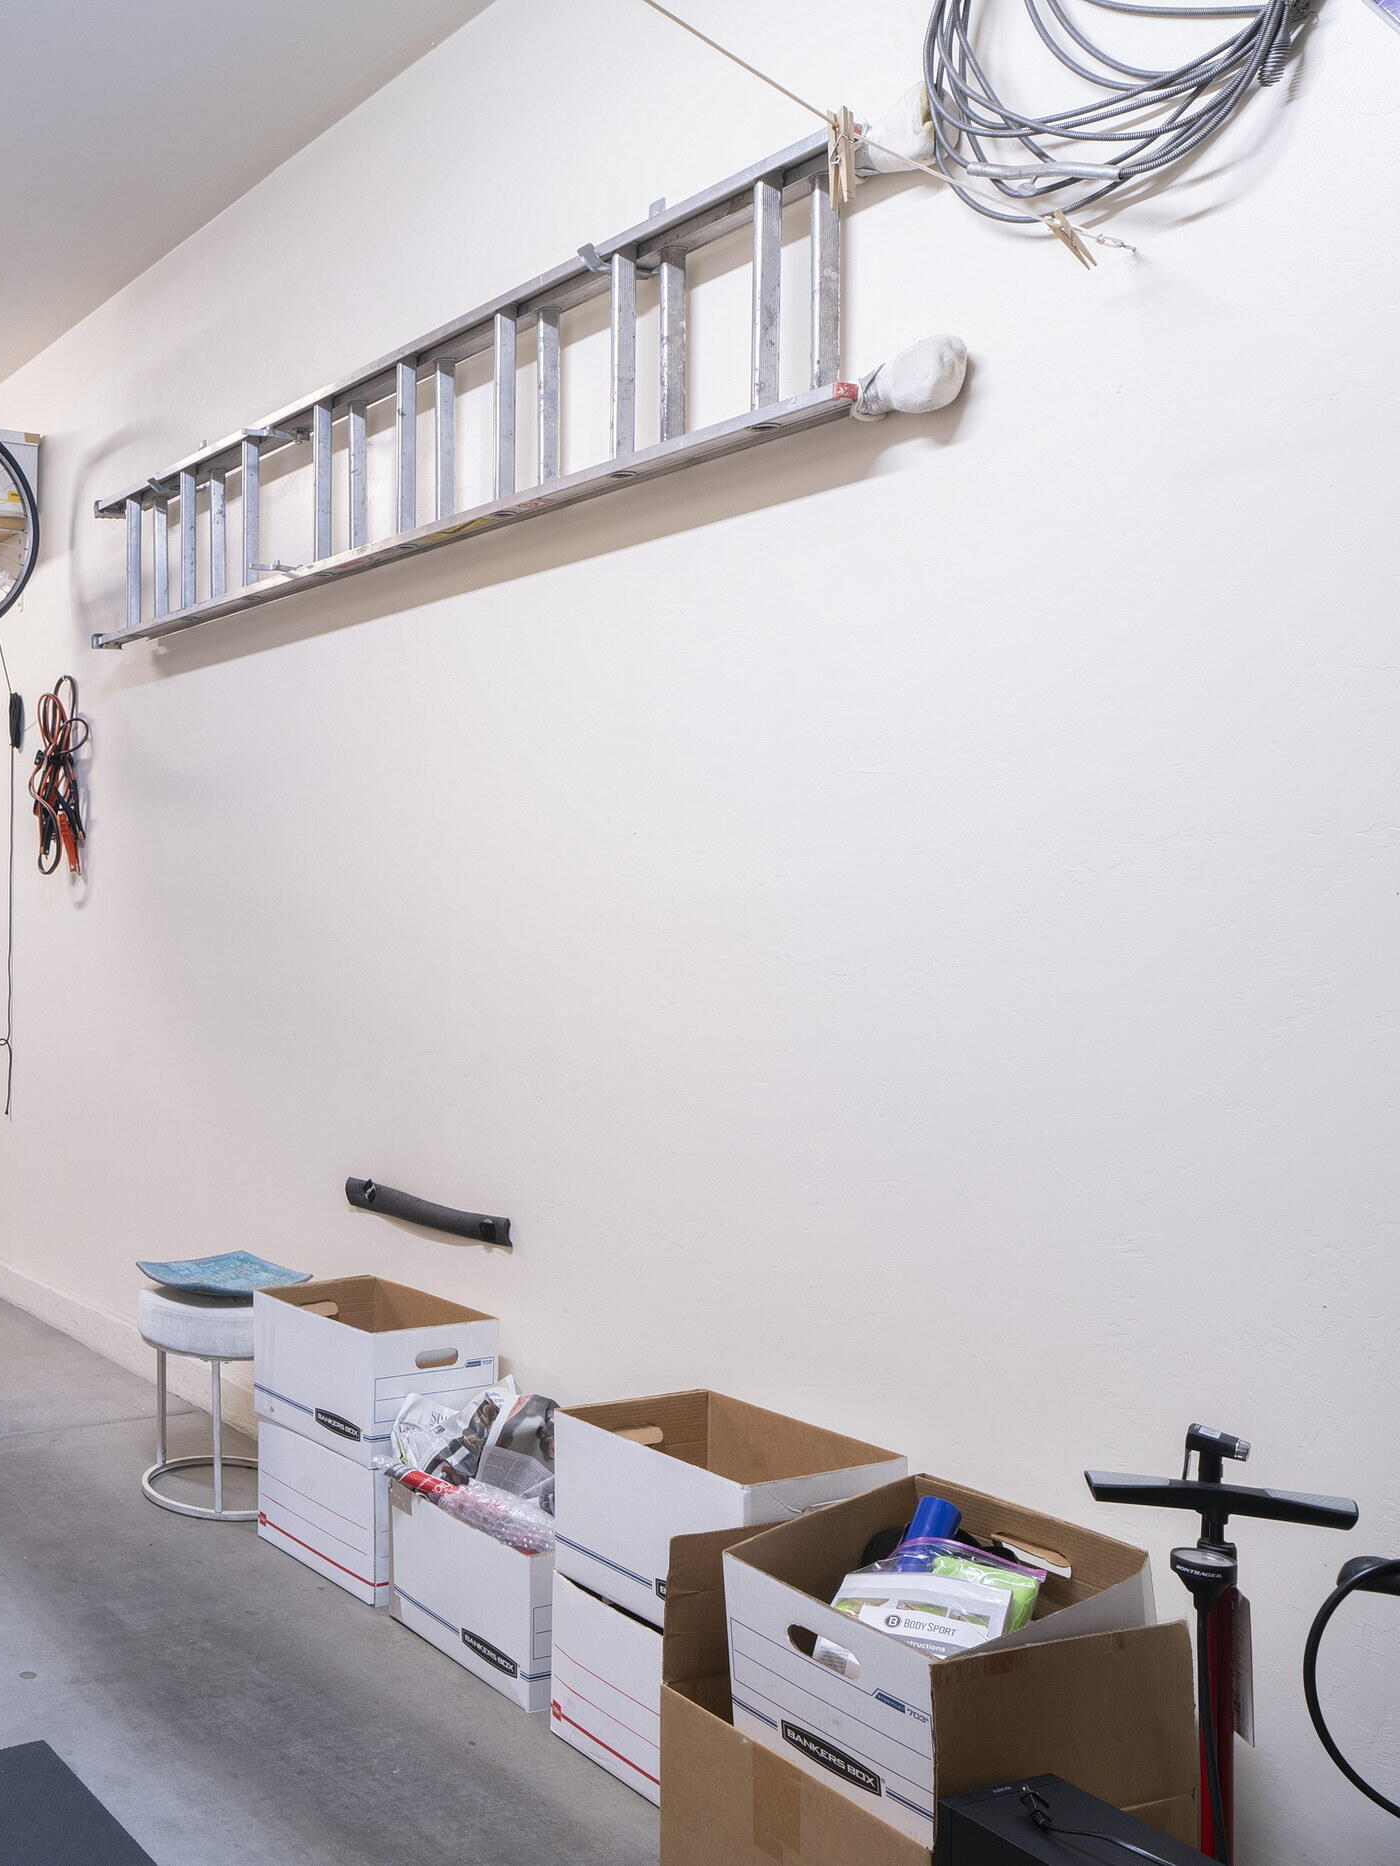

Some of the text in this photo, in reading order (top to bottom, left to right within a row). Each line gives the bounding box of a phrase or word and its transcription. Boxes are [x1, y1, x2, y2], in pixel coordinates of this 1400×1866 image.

[1176, 1564, 1223, 1579] BONTRAGER
[927, 1622, 957, 1637] SPORT
[464, 1634, 514, 1672] BANKERS BOX
[906, 1640, 946, 1653] tructions
[786, 1728, 876, 1787] BANKERS BOX
